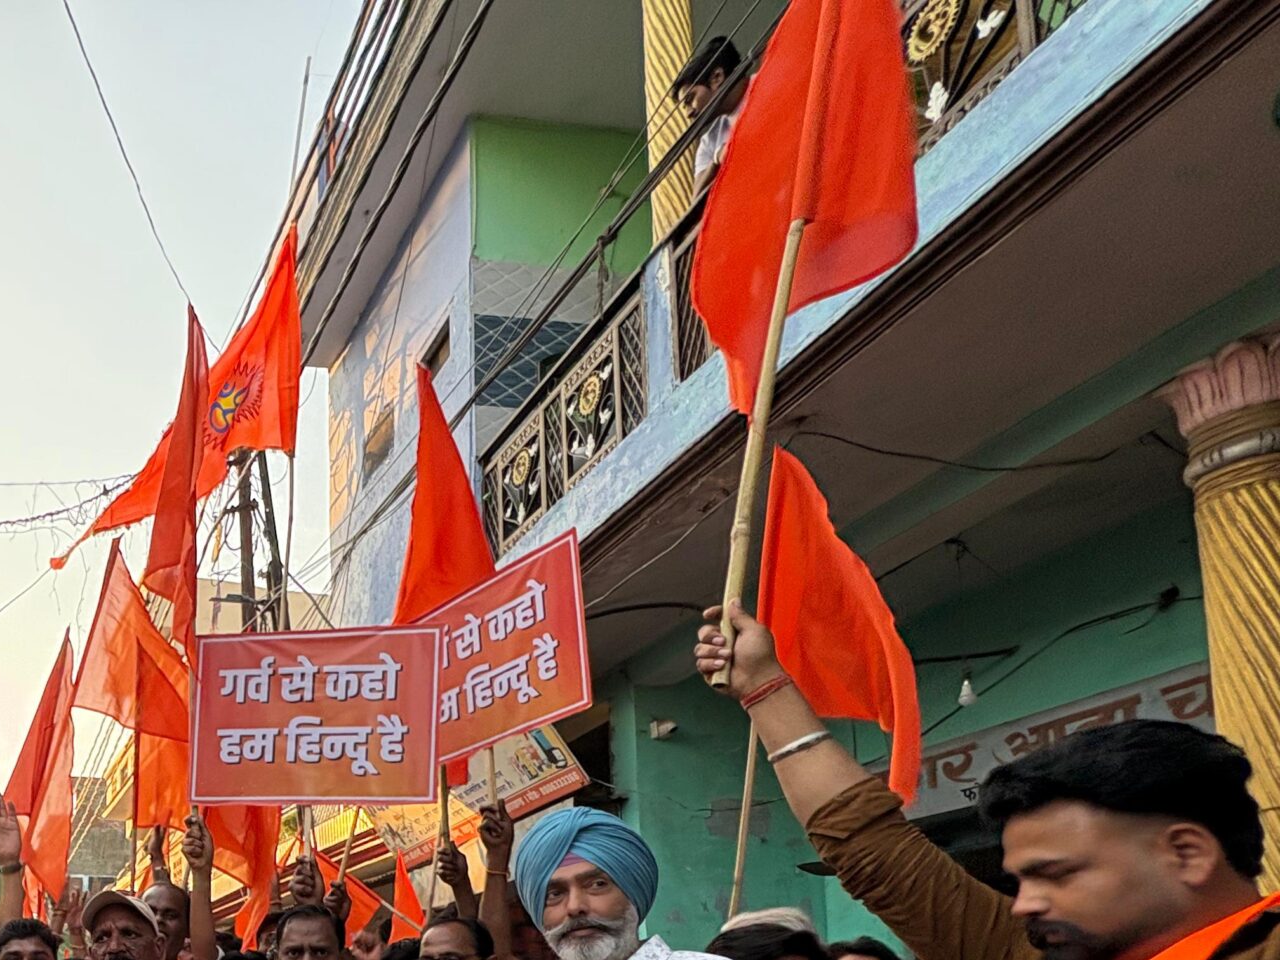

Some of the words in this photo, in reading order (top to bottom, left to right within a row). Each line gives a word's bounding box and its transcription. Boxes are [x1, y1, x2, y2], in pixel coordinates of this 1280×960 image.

[452, 613, 482, 660] से
[484, 579, 546, 642] कहो
[219, 656, 275, 703] गर्व
[278, 655, 319, 702] से
[323, 652, 403, 700] कहो
[440, 686, 461, 724] म
[463, 653, 541, 714] हिन्दू
[217, 727, 279, 764] हम
[283, 715, 380, 776] हिन्दू
[376, 714, 409, 763] है
